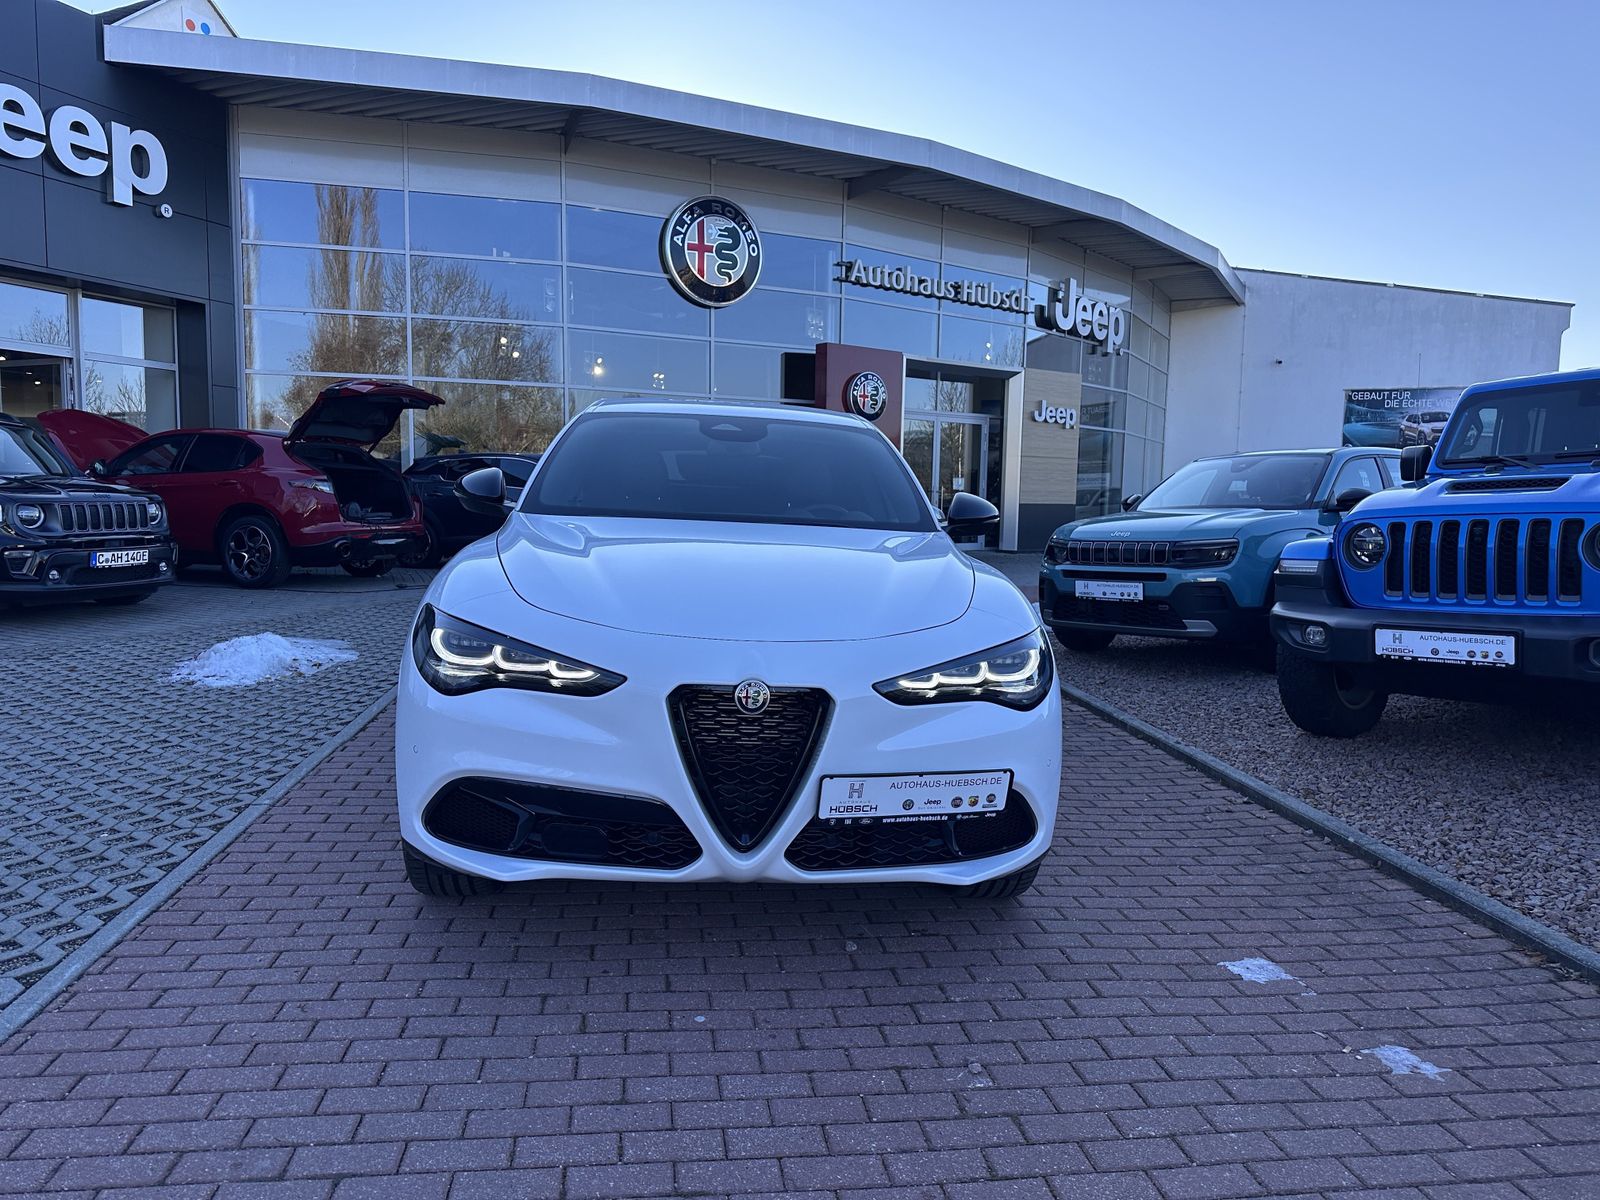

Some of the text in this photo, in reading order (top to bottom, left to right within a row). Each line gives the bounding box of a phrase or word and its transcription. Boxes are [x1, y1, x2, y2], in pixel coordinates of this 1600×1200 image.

[851, 259, 1031, 312] Autohaus Hübsch
[1056, 277, 1125, 354] Jeep
[853, 374, 887, 400] ALFA ROMEO
[1351, 391, 1390, 401] GEBAUT
[1384, 399, 1400, 408] DIE
[1402, 399, 1433, 408] ECHTE
[1034, 400, 1077, 429] Jeep
[1110, 530, 1131, 538] Jeep
[890, 776, 1003, 790] AUTOHAUS-HUEBSCH.DE
[923, 798, 942, 806] Jeep
